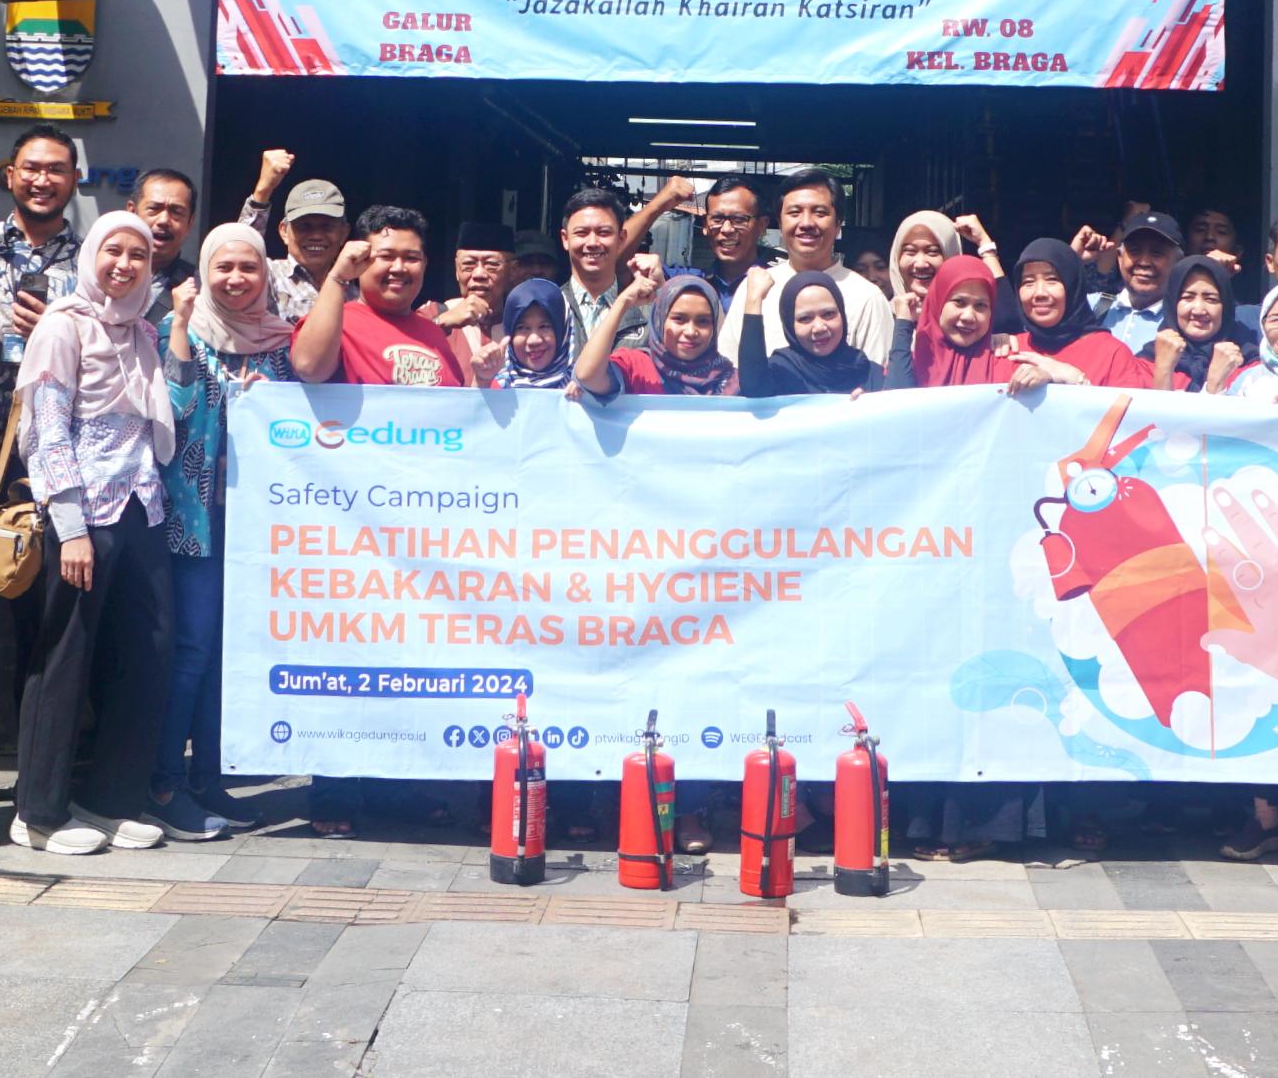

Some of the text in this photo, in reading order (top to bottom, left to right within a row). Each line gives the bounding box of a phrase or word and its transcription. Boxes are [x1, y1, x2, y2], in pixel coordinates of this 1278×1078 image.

[382, 11, 472, 32] GALUR
[941, 18, 1034, 39] RW. 08
[379, 42, 472, 64] BRAGA
[906, 50, 1068, 73] KEL. BRAGA
[269, 482, 519, 514] Safety Campaign
[270, 524, 973, 560] PELATIHAN PENANGGULANGAN
[270, 567, 802, 603] KEBAKARAN & HYGIENE
[269, 610, 735, 647] UMKM TERAS BRAGA
[358, 673, 371, 692] 2
[378, 673, 465, 693] Februari
[471, 674, 528, 694] 2024
[296, 727, 427, 743] www.wikagedung.co.id
